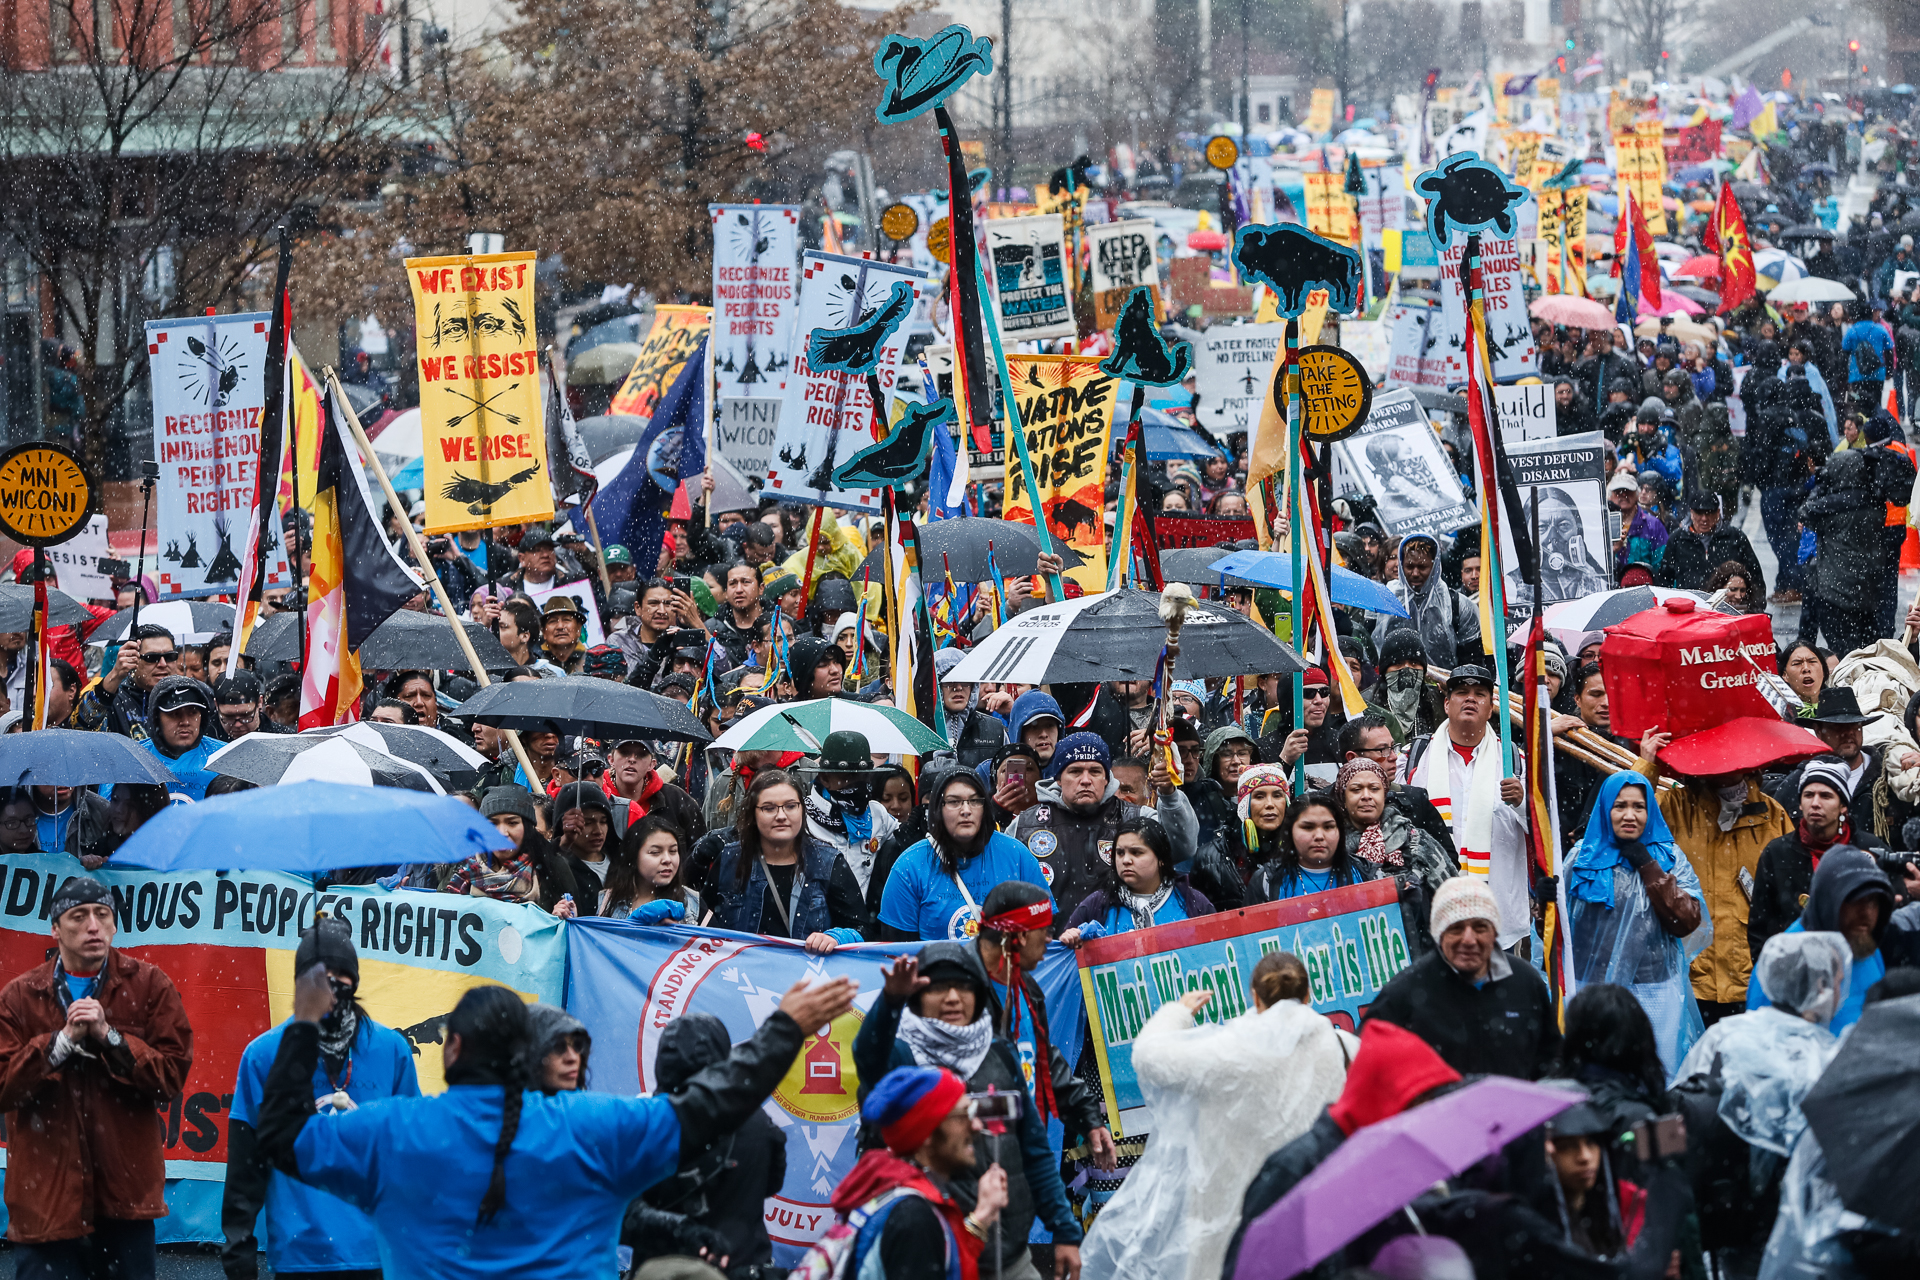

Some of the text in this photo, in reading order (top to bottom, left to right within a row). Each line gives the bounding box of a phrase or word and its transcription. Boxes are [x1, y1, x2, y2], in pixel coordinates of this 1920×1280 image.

[1098, 233, 1144, 262] KEEP
[417, 264, 527, 294] WE EXIST
[719, 266, 790, 282] RECOGNIZE
[717, 284, 792, 299] INDIGENOUS
[1001, 284, 1064, 303] PROTECT THE
[725, 302, 780, 318] PEOPLES
[1002, 295, 1066, 316] WATER
[730, 321, 774, 335] RIGHTS
[1206, 340, 1242, 351] WATER
[421, 350, 537, 382] WE RESIST
[1216, 353, 1229, 363] NO
[1300, 365, 1337, 381] TAKE
[804, 382, 874, 409] PEOPLES
[1308, 383, 1333, 395] THE
[733, 402, 776, 423] MNI
[1308, 394, 1357, 412] EETING
[1372, 402, 1412, 419] DEFUND
[164, 406, 264, 436] RECOGNIZ
[806, 406, 865, 432] RIGHTS
[1360, 417, 1399, 434] DISARM
[1501, 417, 1525, 430] That
[160, 433, 261, 464] INDIGENOU
[440, 433, 533, 463] WE RISE
[1544, 451, 1594, 466] DEFUND
[20, 467, 58, 489] MNI
[1522, 468, 1572, 483] DISARM
[0, 488, 76, 513] WICONI
[187, 487, 254, 514] RIGHTS
[1396, 505, 1466, 532] ALL PIPELINES
[608, 548, 621, 559] P
[1018, 618, 1061, 628] adidas
[1183, 615, 1228, 624] didas
[1679, 645, 1735, 667] Make
[1700, 671, 1748, 689] Great
[182, 769, 197, 777] with
[360, 898, 484, 967] RIGHTS
[1093, 960, 1150, 1047] Mni
[1330, 922, 1364, 998] is
[1358, 911, 1412, 992] life
[653, 953, 702, 1029] STANDING
[782, 1101, 806, 1119] SOLDIER
[809, 1114, 838, 1122] RUNNING
[765, 1207, 822, 1231] JULY
